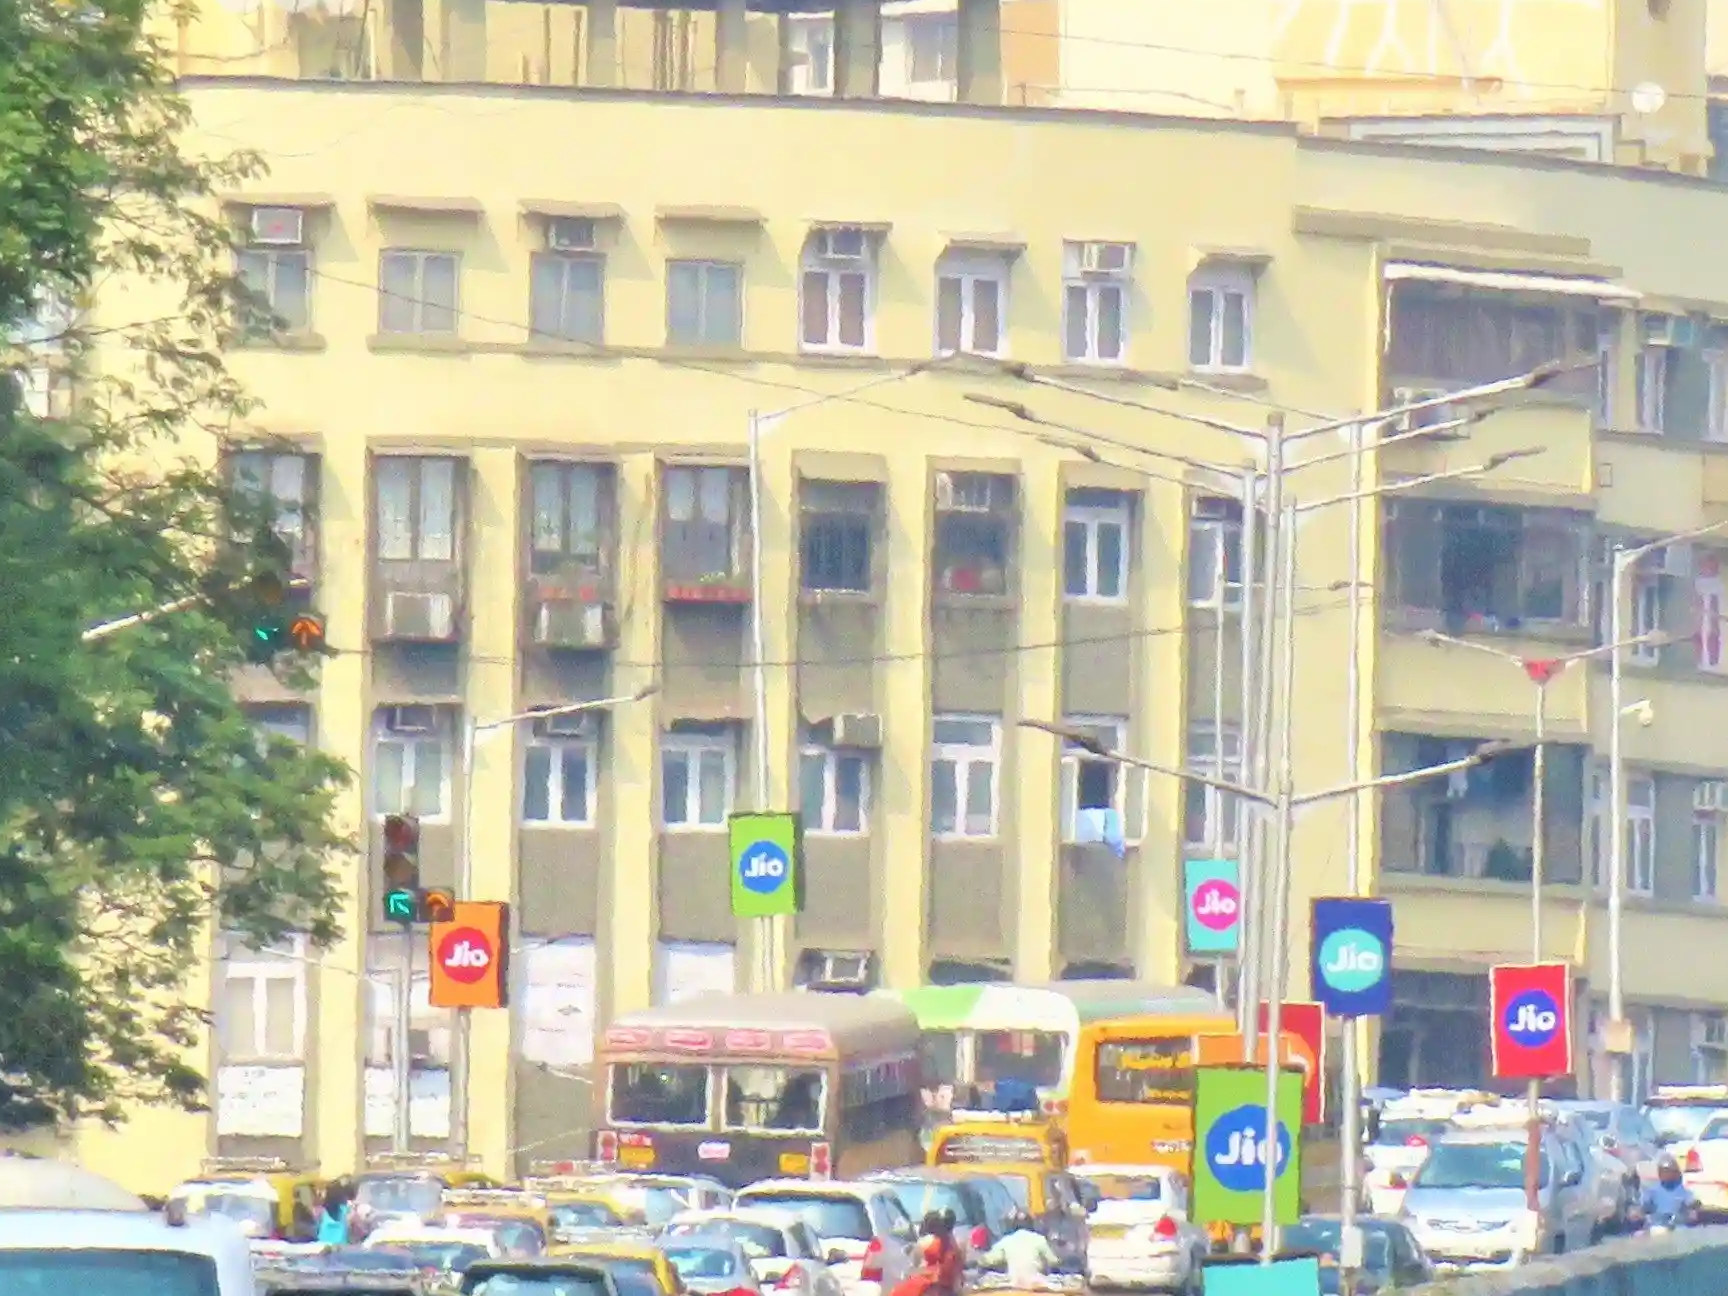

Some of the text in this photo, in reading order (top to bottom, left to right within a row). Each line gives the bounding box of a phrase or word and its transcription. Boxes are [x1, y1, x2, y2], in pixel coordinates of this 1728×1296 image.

[744, 852, 784, 878] Jio
[1196, 887, 1237, 915] Jio
[444, 941, 489, 968] Jio
[1328, 943, 1381, 973] Jio
[1508, 1003, 1556, 1032] Jio
[1214, 1125, 1283, 1166] Jio
